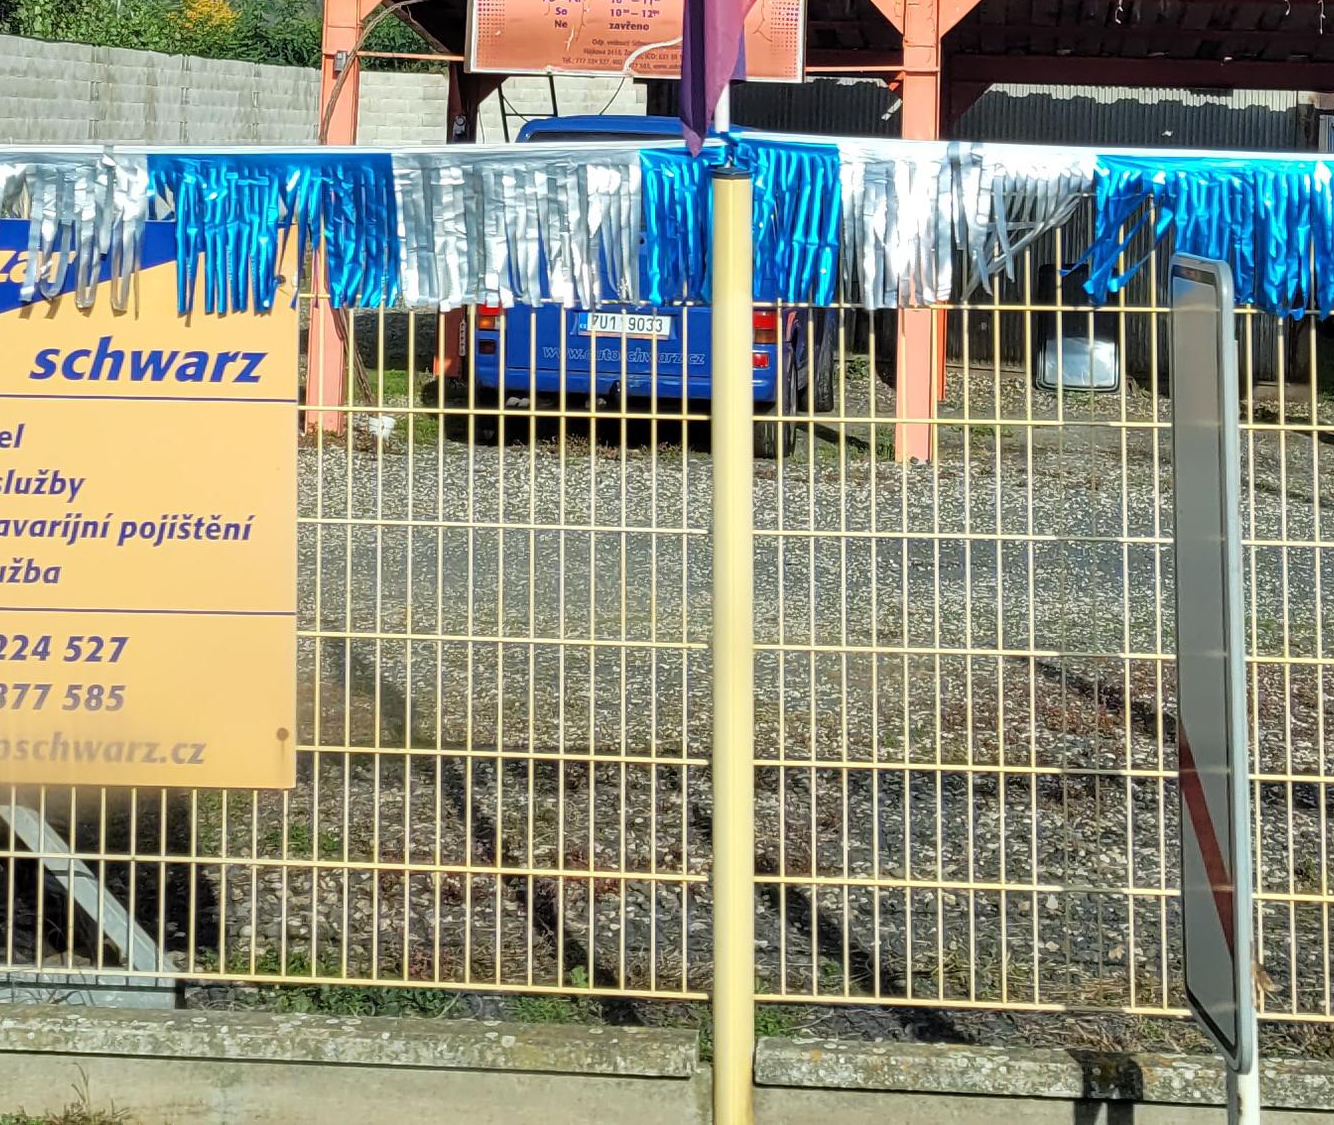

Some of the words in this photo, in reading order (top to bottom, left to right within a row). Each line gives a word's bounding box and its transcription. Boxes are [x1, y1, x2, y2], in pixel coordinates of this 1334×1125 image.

[555, 6, 568, 16] So
[554, 19, 568, 29] Ne
[609, 19, 650, 32] zavřeno
[28, 335, 269, 383] schwarz
[116, 513, 256, 548] pojištění
[62, 636, 130, 663] 527
[62, 684, 127, 712] 585
